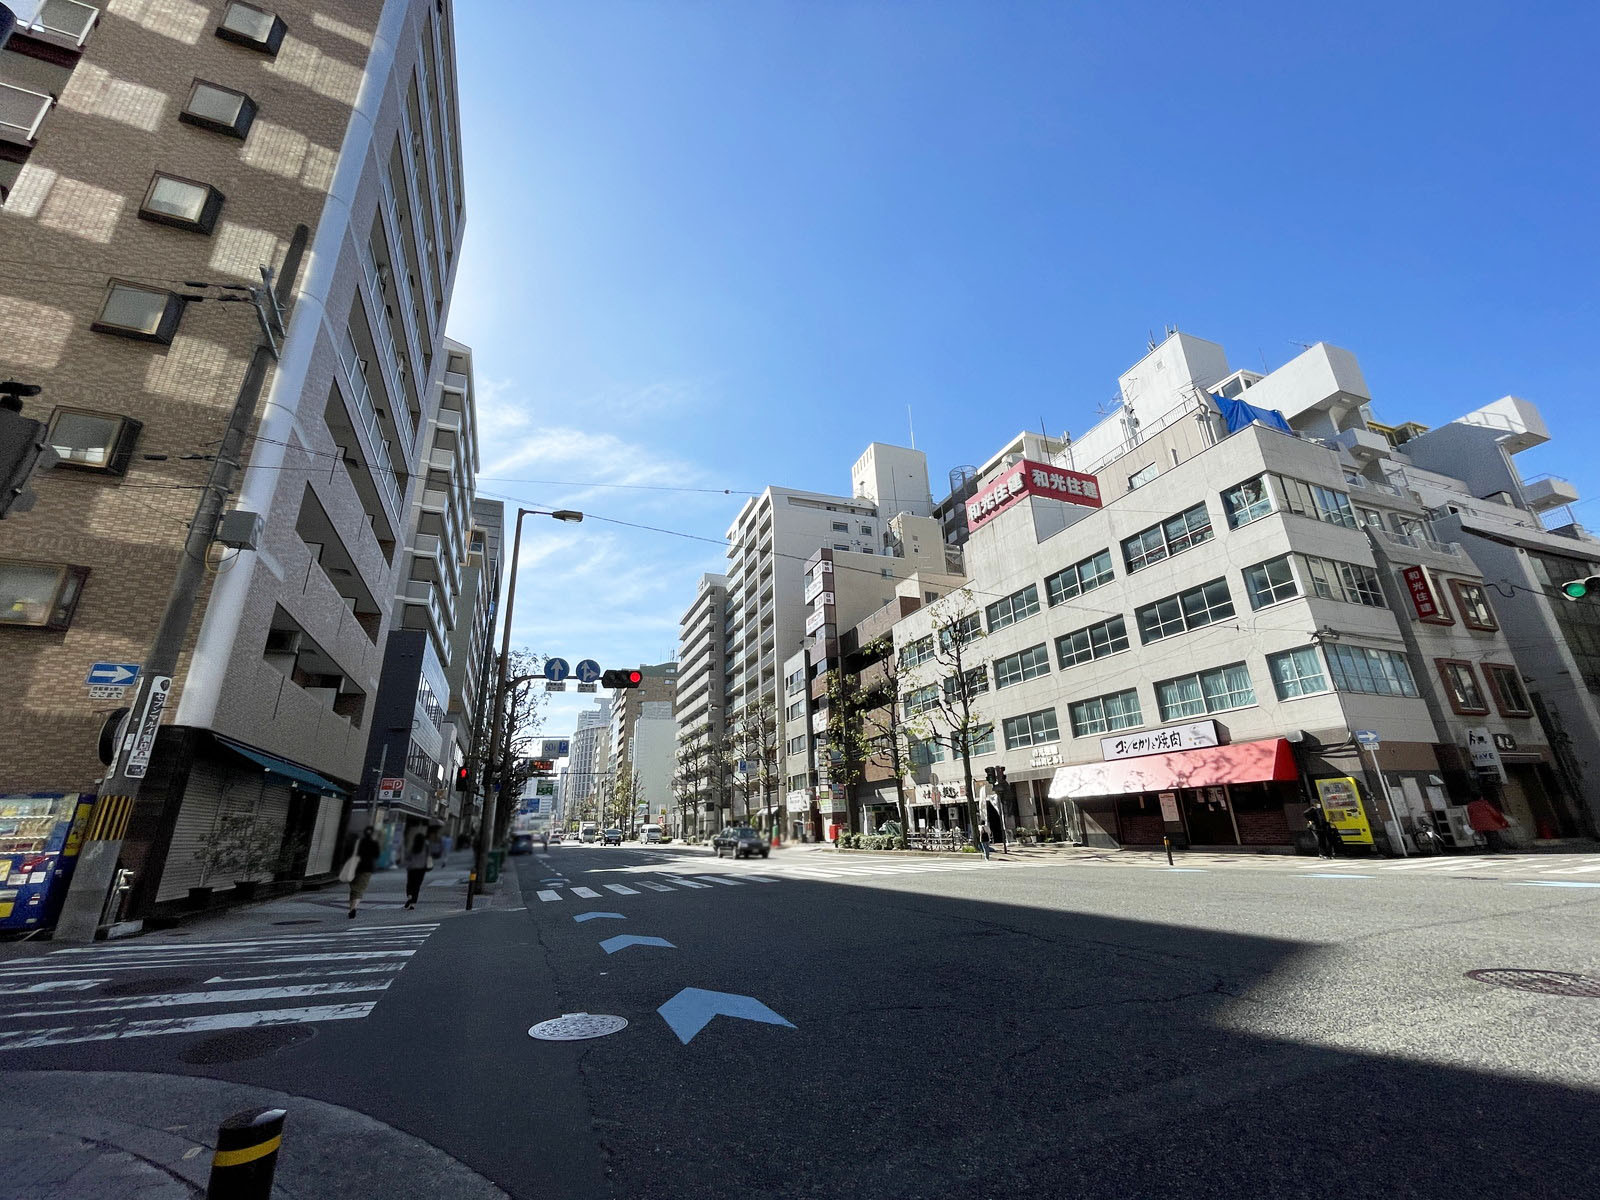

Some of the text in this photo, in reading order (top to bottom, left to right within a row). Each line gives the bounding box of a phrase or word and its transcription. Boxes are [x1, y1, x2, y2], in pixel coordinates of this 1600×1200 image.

[968, 472, 1024, 521] 和光住建
[1031, 469, 1099, 499] 和光住建
[1408, 571, 1433, 613] 和光住建
[1115, 730, 1182, 754] コシヒカリと焼肉
